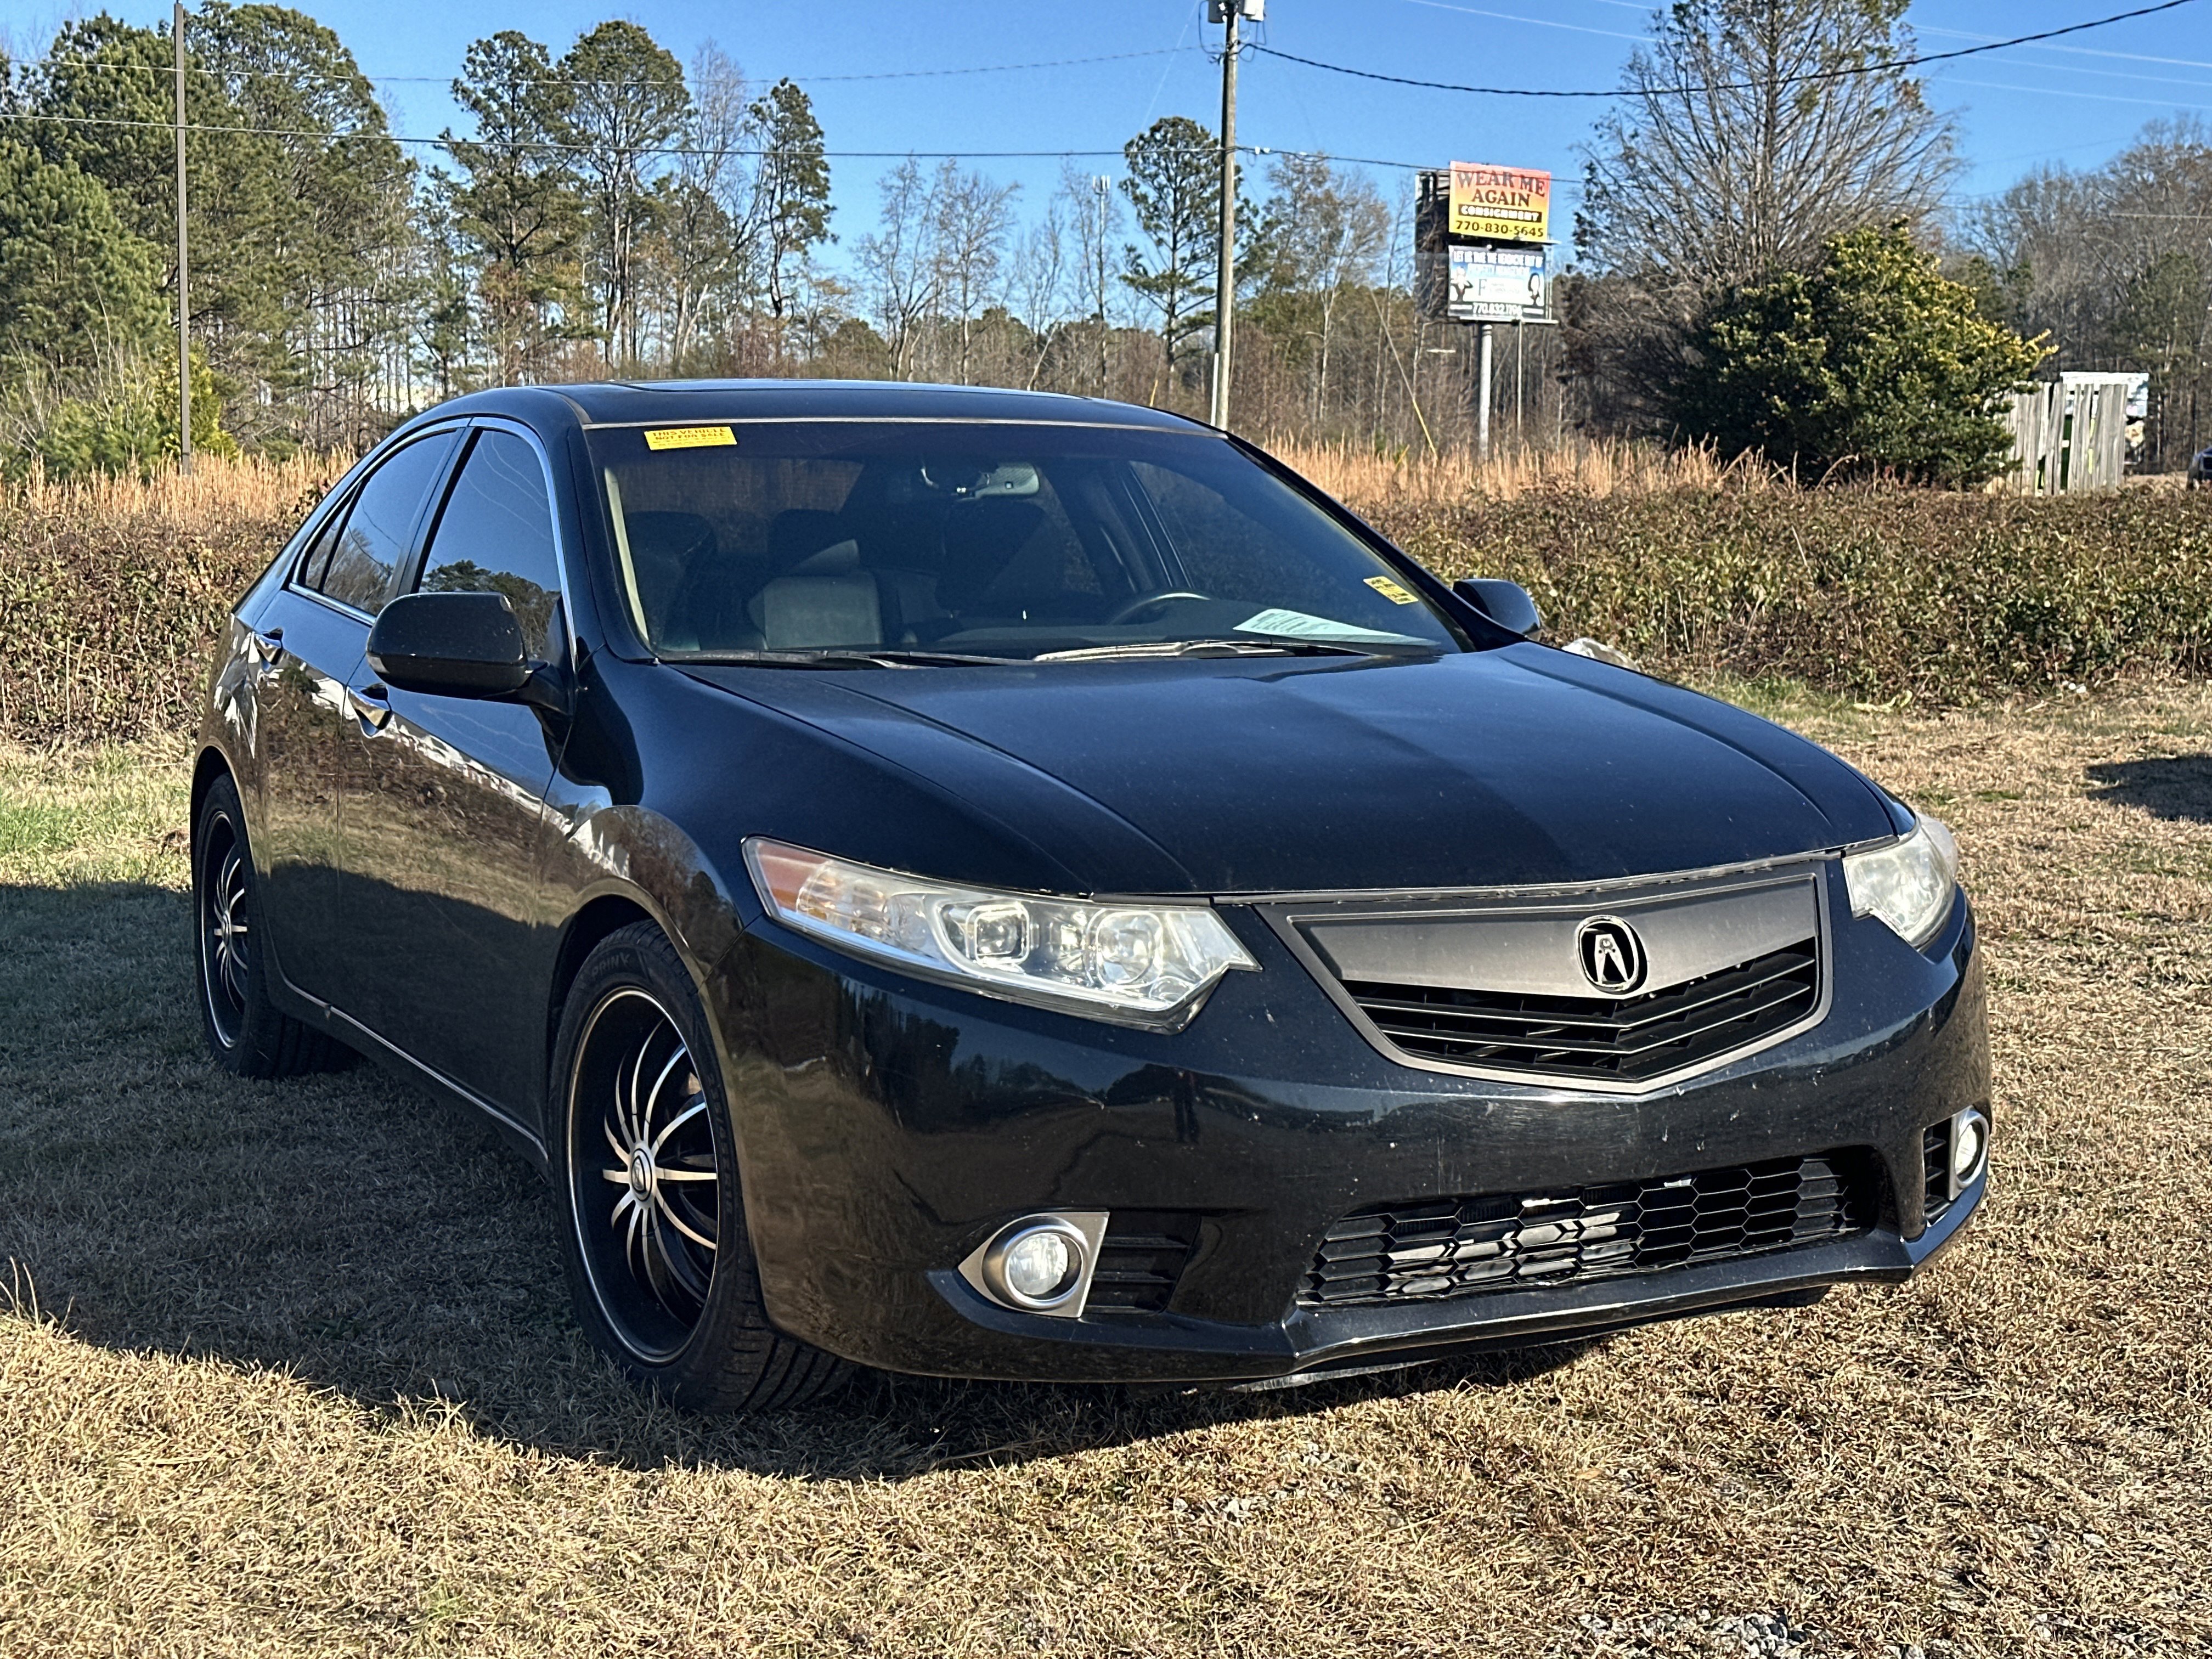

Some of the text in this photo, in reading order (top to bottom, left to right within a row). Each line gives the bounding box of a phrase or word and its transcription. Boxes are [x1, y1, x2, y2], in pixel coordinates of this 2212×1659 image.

[1456, 170, 1545, 198] WEAR ME
[1471, 189, 1531, 207] AGAIN
[1460, 205, 1539, 222] CONSIGNMENT
[1455, 221, 1544, 238] 770-830-5645
